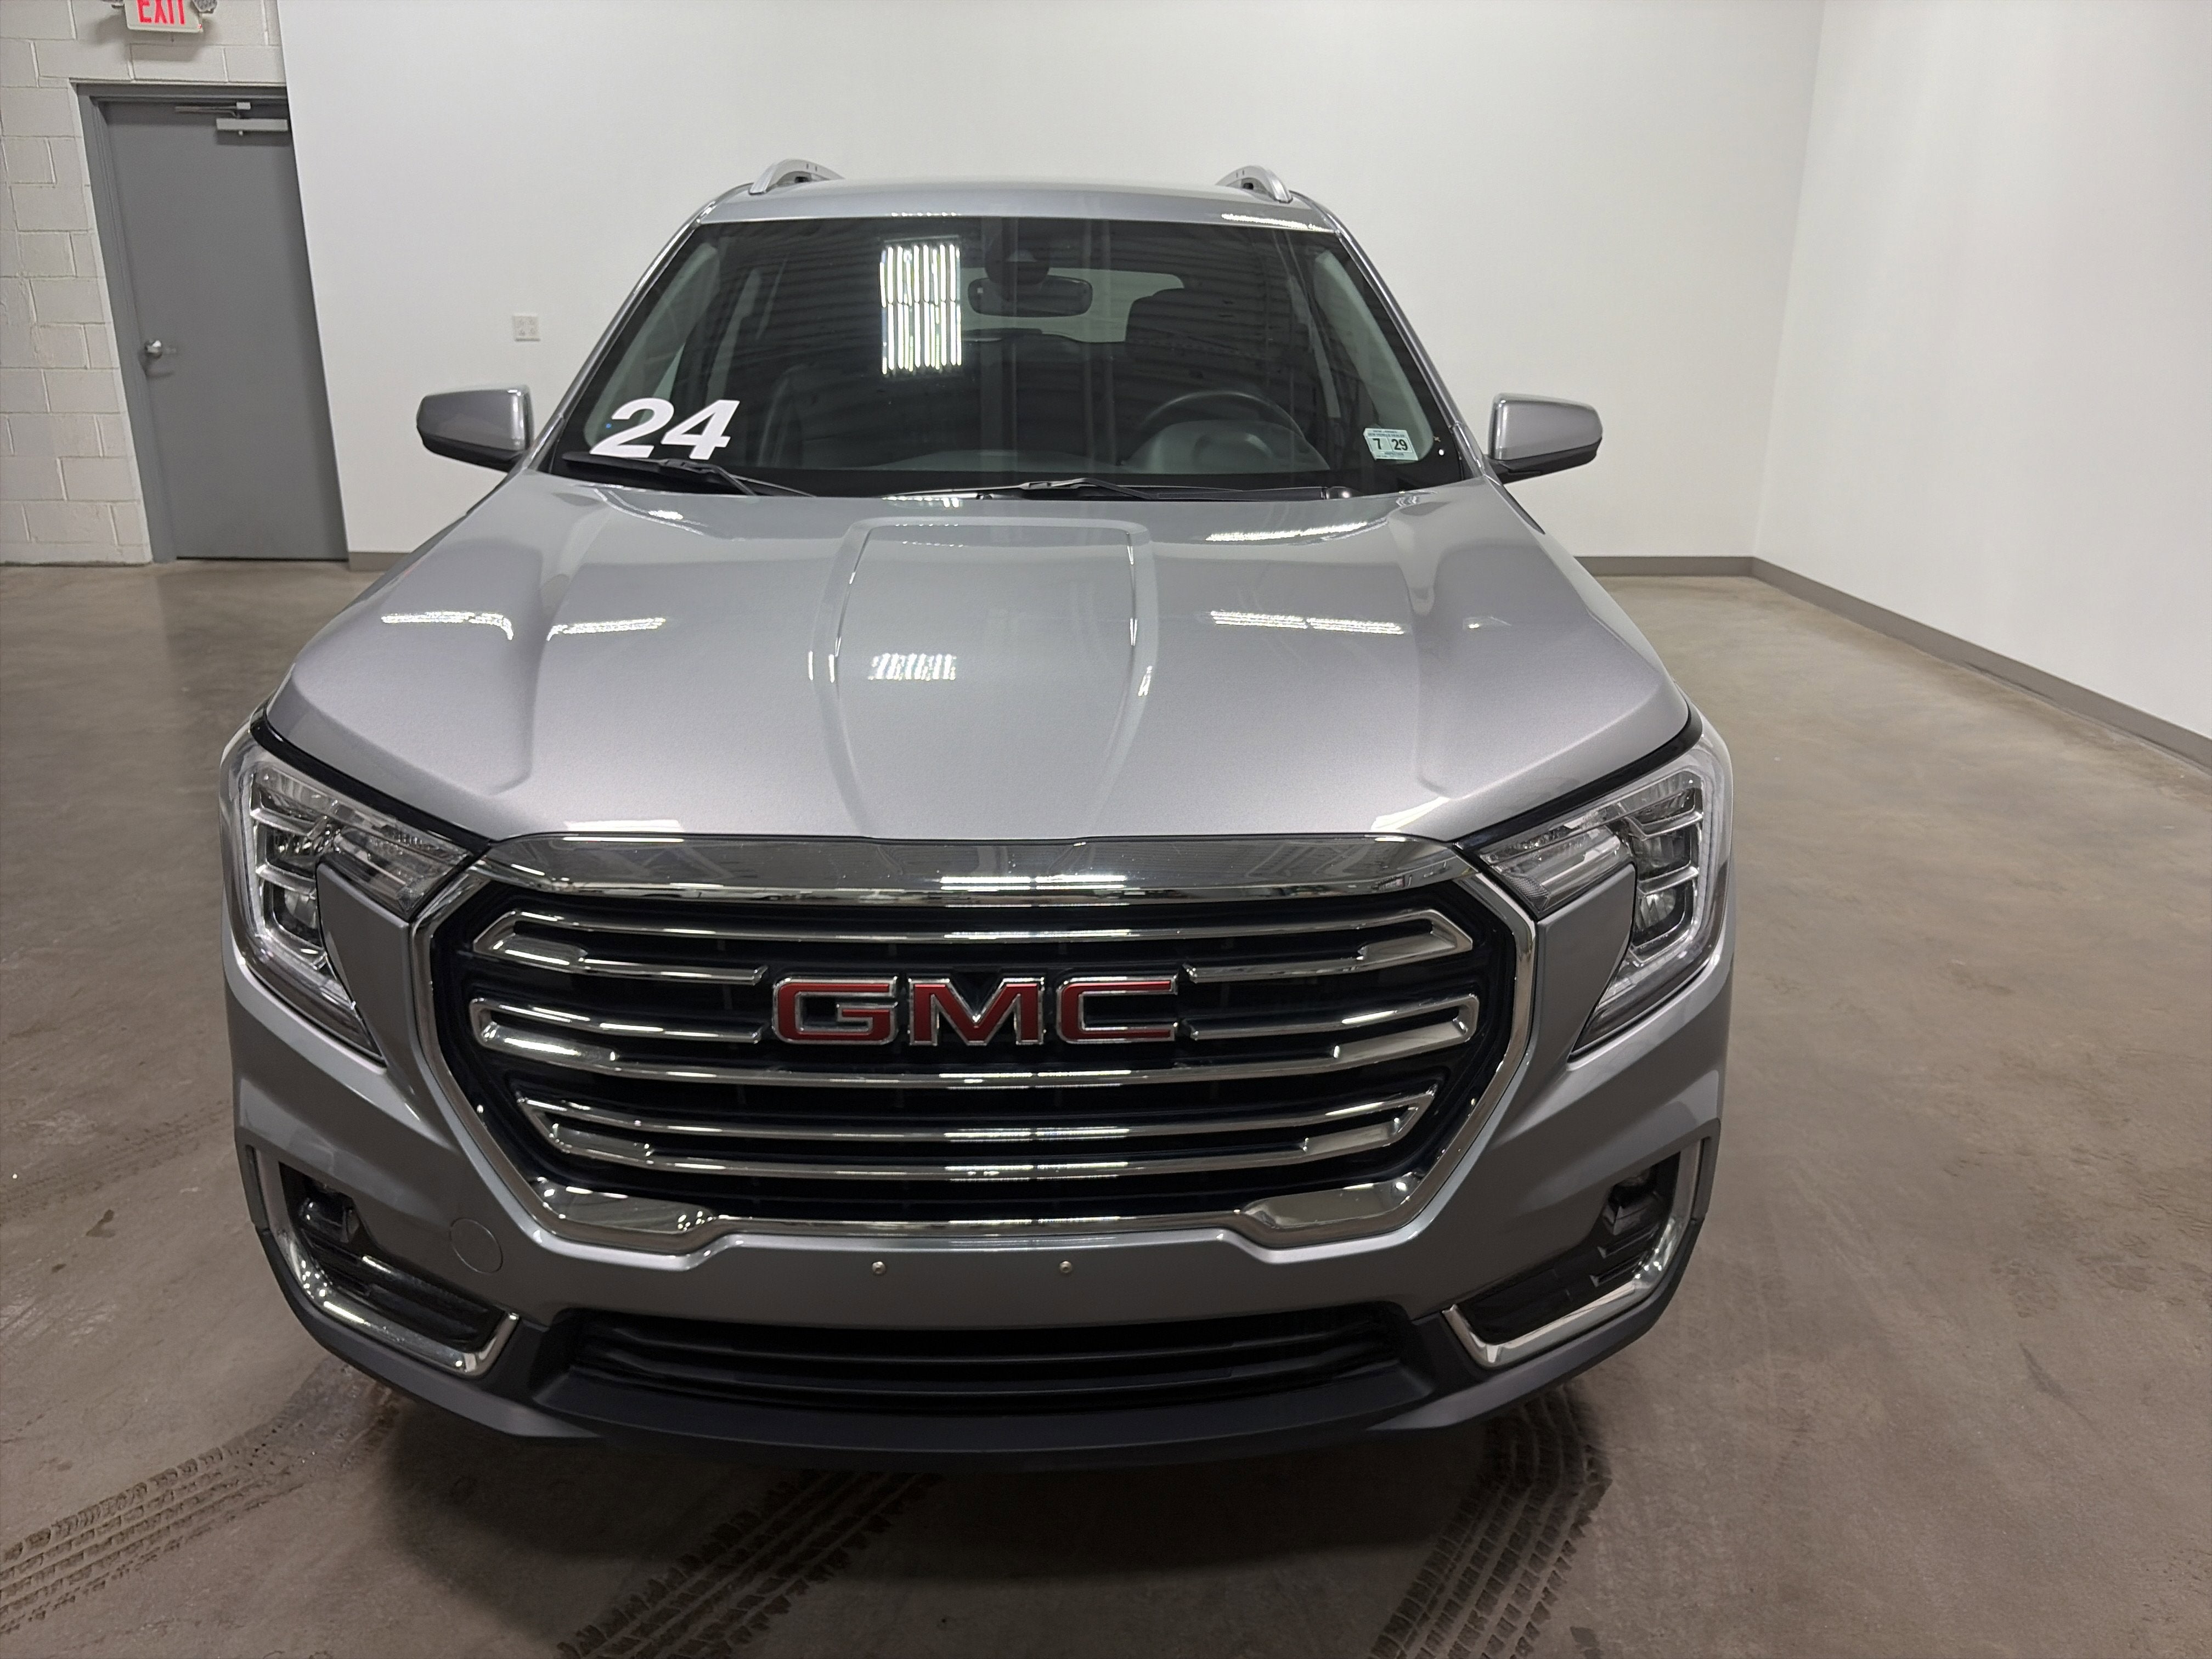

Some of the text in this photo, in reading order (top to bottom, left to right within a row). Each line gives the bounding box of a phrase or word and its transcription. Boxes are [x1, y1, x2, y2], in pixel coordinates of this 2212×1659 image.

[589, 397, 740, 460] 24
[1373, 438, 1408, 450] 7 29
[772, 973, 1178, 1046] GMC
